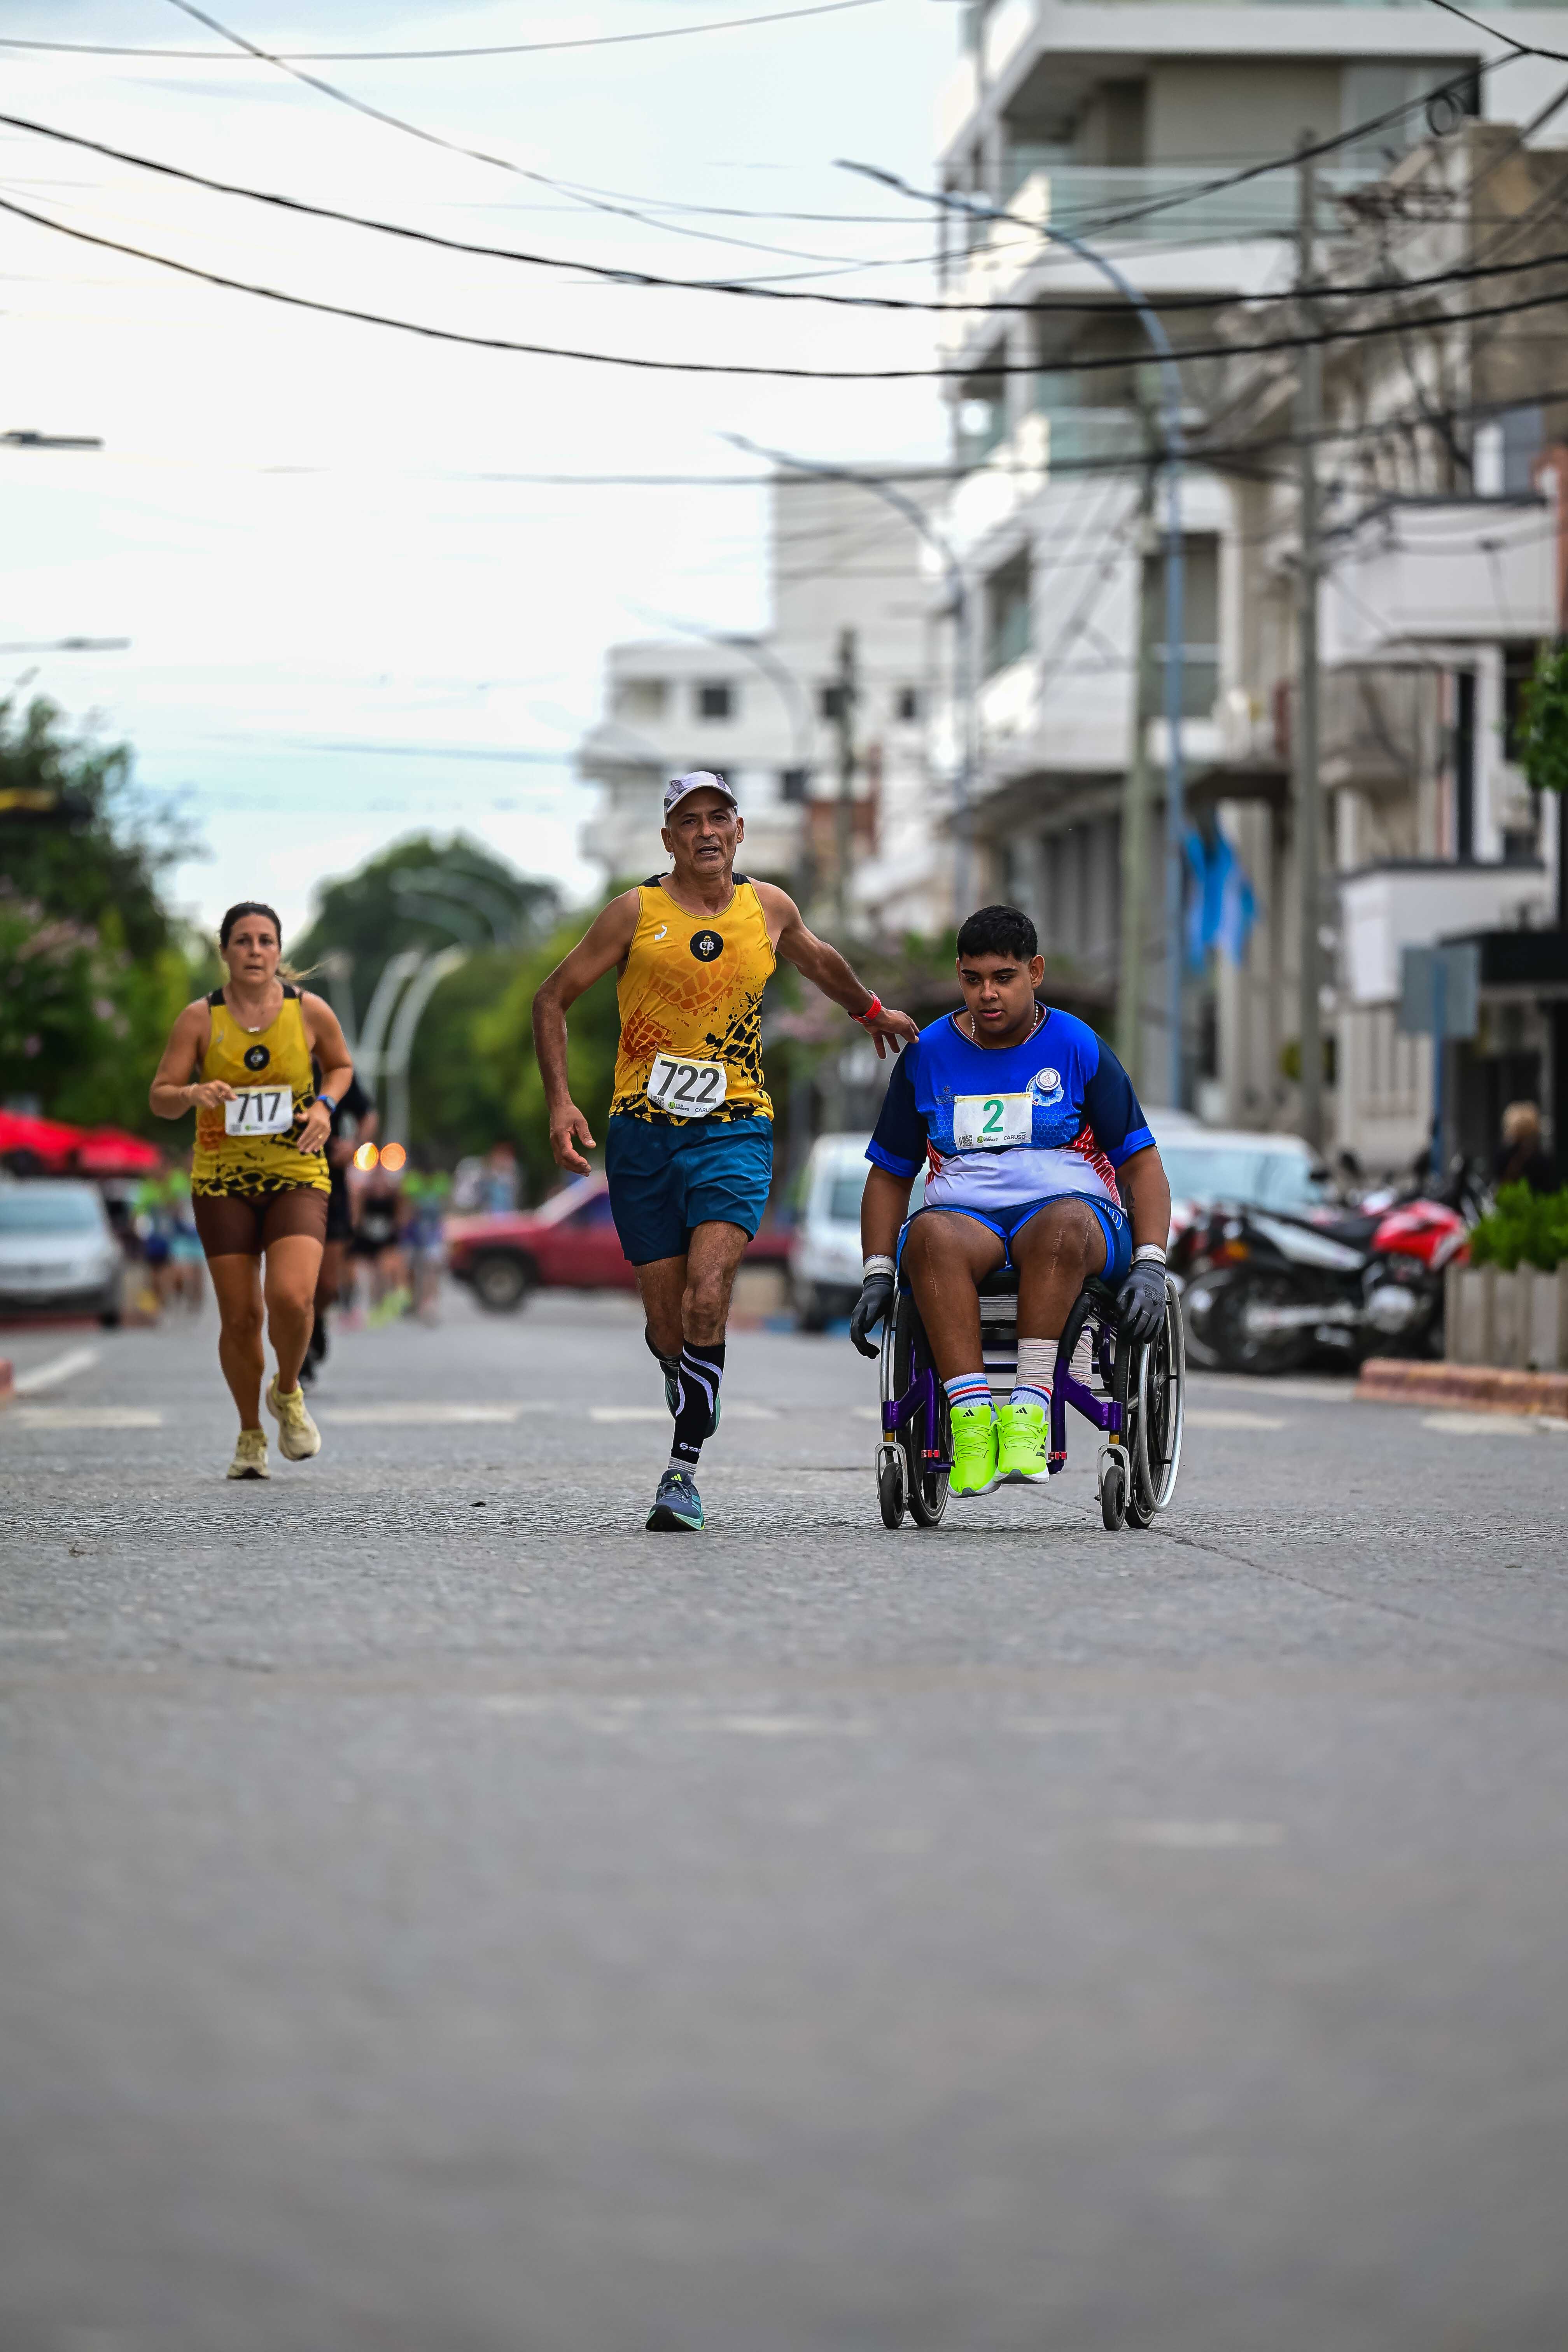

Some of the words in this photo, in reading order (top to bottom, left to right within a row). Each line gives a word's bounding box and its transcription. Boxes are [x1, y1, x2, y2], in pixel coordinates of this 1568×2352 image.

[700, 942, 714, 950] CB
[657, 1060, 720, 1103] 722
[236, 1092, 280, 1123] 717
[982, 1099, 1004, 1133] 2
